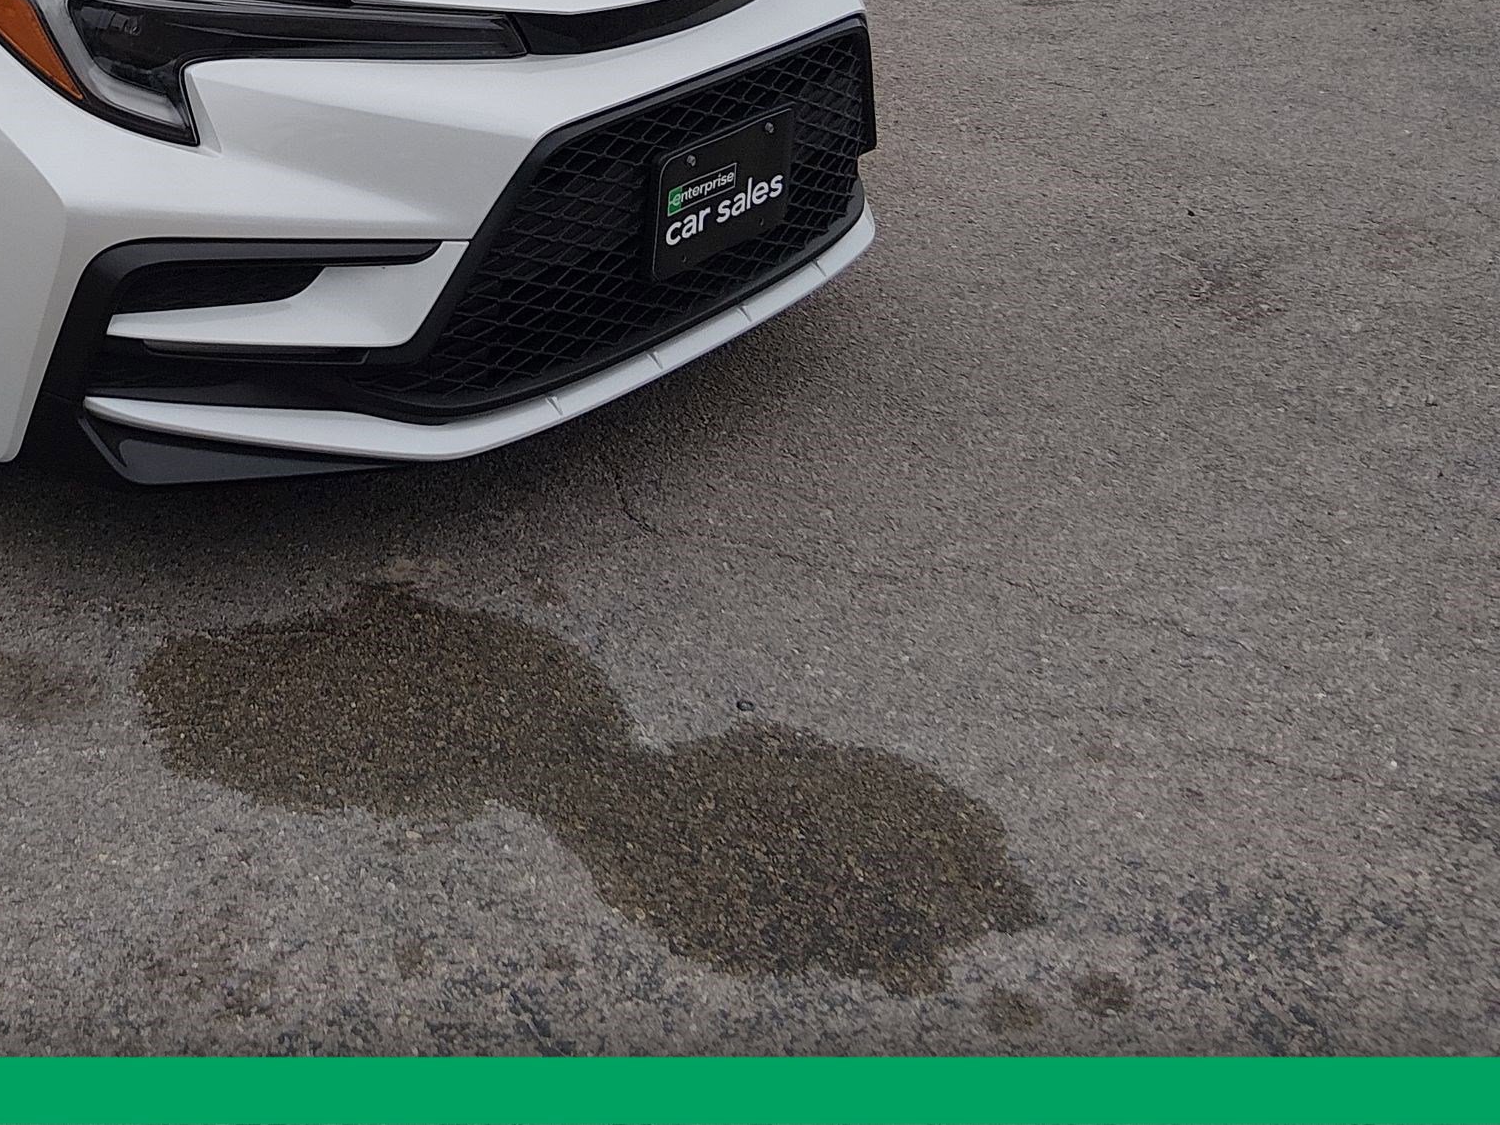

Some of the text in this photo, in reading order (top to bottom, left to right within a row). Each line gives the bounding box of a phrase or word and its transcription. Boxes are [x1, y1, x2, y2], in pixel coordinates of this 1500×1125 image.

[665, 174, 784, 246] car sales
[669, 171, 736, 207] enterprise
